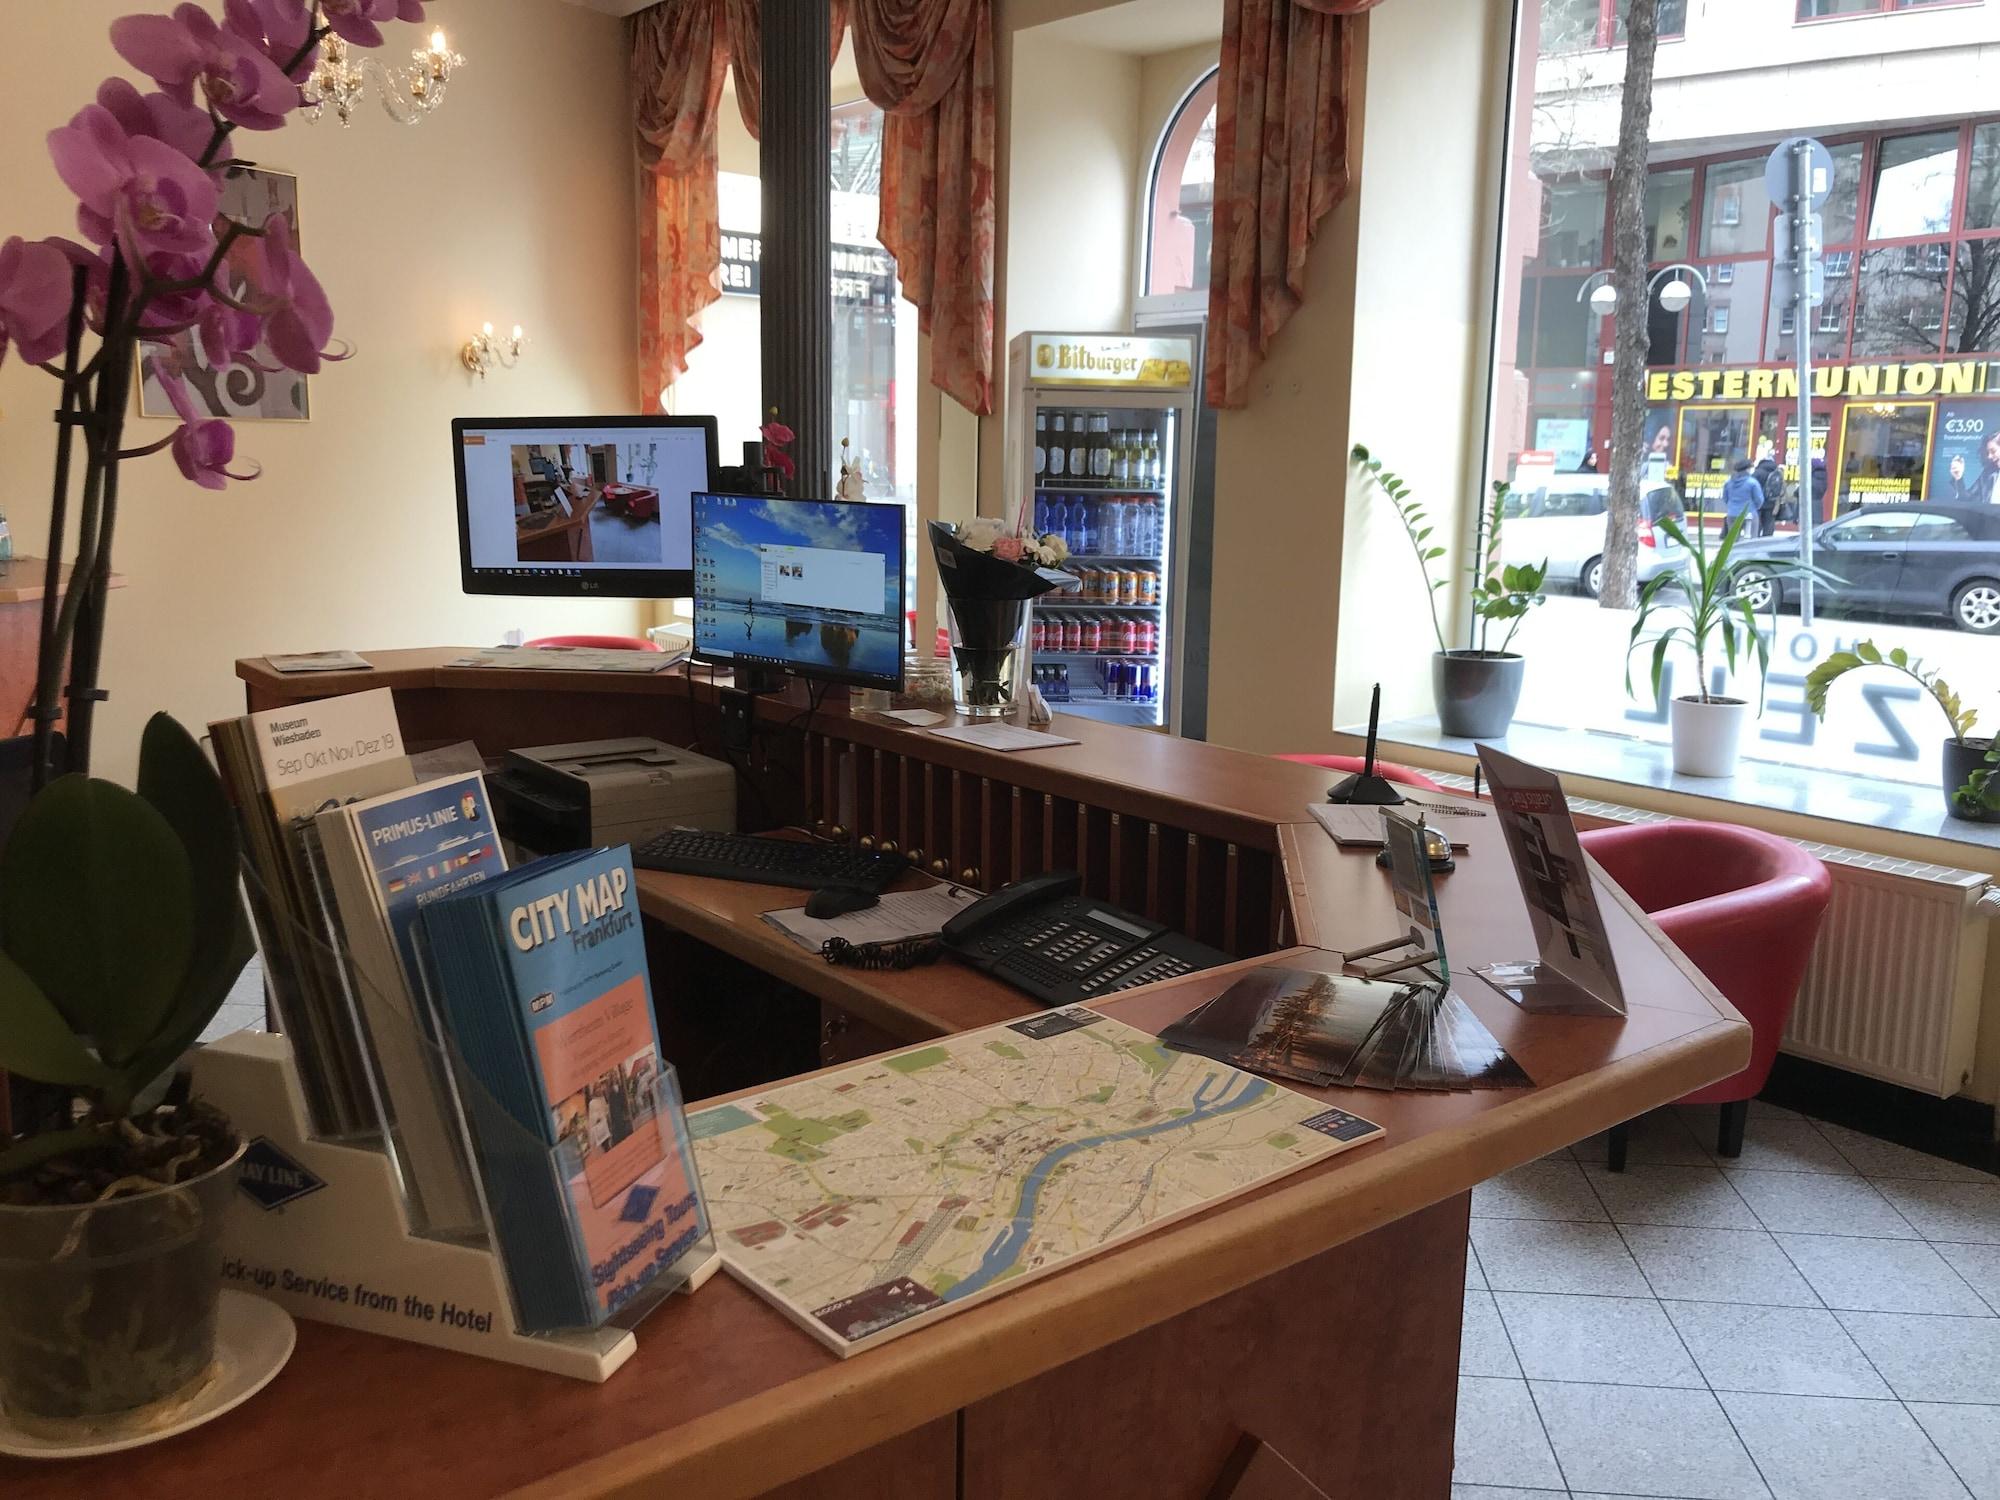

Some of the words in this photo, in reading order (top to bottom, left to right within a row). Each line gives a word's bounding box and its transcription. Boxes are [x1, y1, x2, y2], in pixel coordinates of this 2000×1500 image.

[1057, 344, 1138, 375] Bitburger
[1645, 368, 1799, 401] ESTERN
[1813, 361, 1976, 397] UNION
[1945, 418, 1984, 433] €3.90
[269, 718, 309, 733] Museum
[272, 728, 322, 747] Wiesbaden
[277, 758, 302, 776] Sep
[304, 752, 328, 769] Okt
[329, 746, 354, 762] Nov
[355, 739, 381, 757] Dez
[382, 733, 395, 750] 19
[372, 805, 459, 847] PRIMUS-LINIE
[509, 888, 572, 952] CITY
[575, 867, 627, 926] MAP
[571, 911, 635, 953] Frankfurt
[240, 1161, 267, 1181] AY
[591, 1218, 665, 1288] Sightseeing
[664, 1190, 698, 1225] Tours
[221, 1256, 277, 1290] ick-up
[281, 1268, 349, 1303] Service
[354, 1283, 398, 1313] from
[403, 1295, 435, 1321] the
[440, 1301, 493, 1333] Hotel
